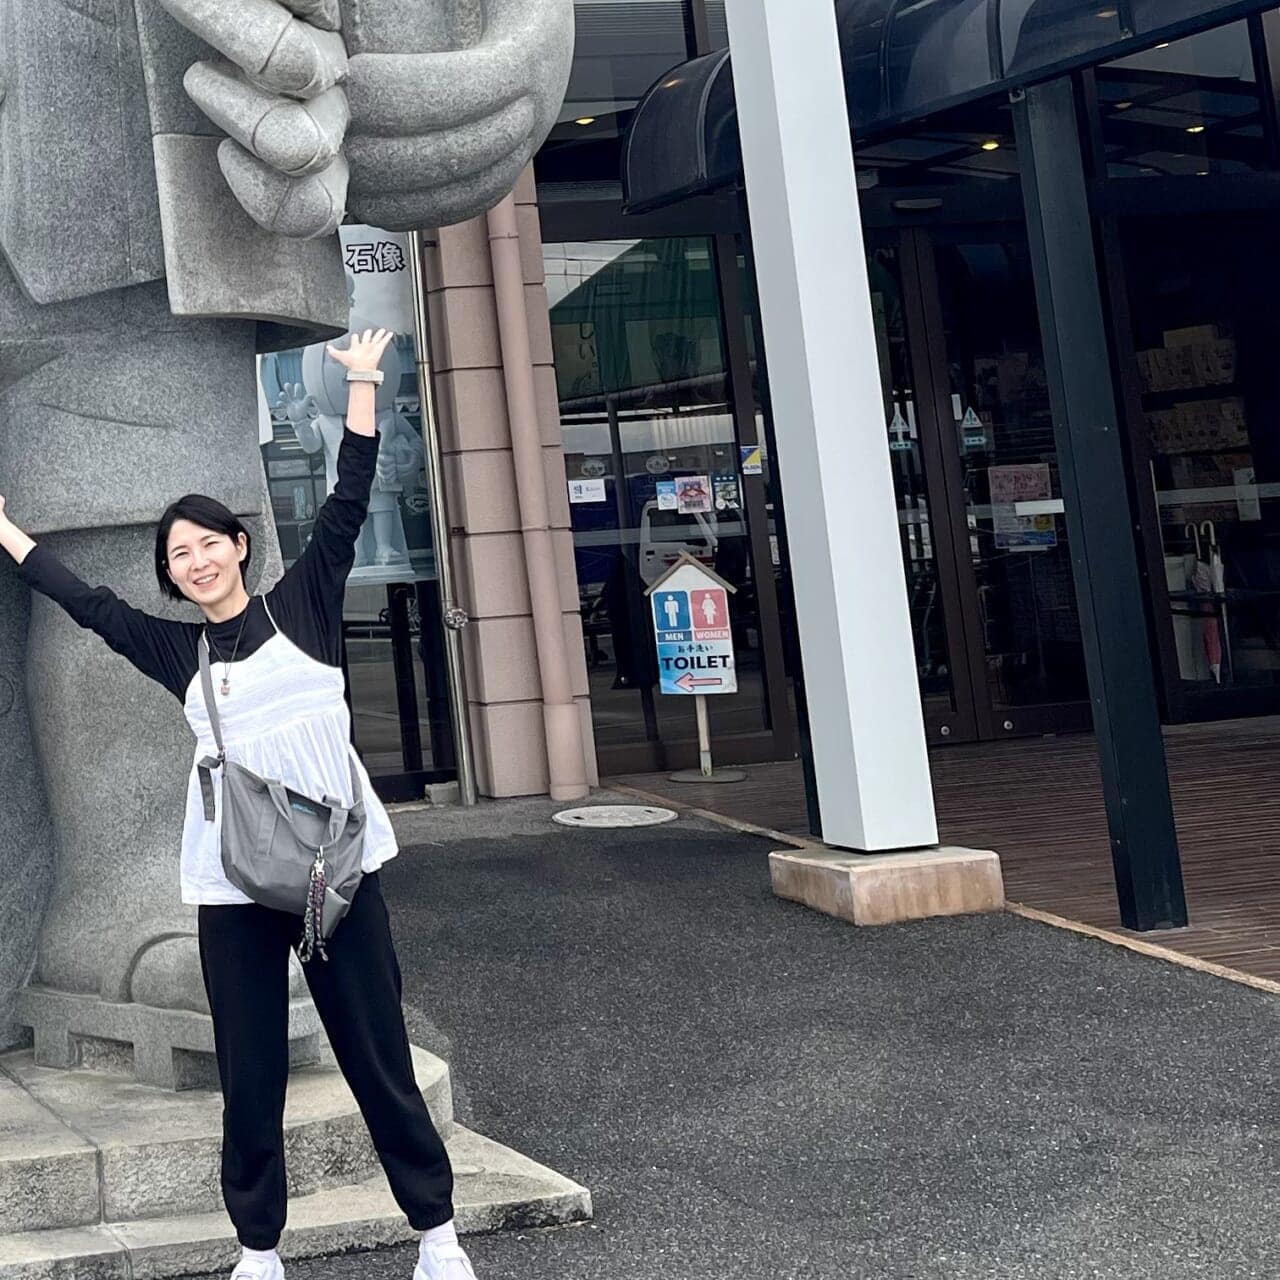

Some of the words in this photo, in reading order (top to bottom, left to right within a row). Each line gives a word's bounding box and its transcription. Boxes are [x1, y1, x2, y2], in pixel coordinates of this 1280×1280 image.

[345, 241, 406, 274] 石像
[665, 632, 684, 641] MEN
[696, 631, 729, 639] WOMEN
[661, 655, 730, 670] TOILET
